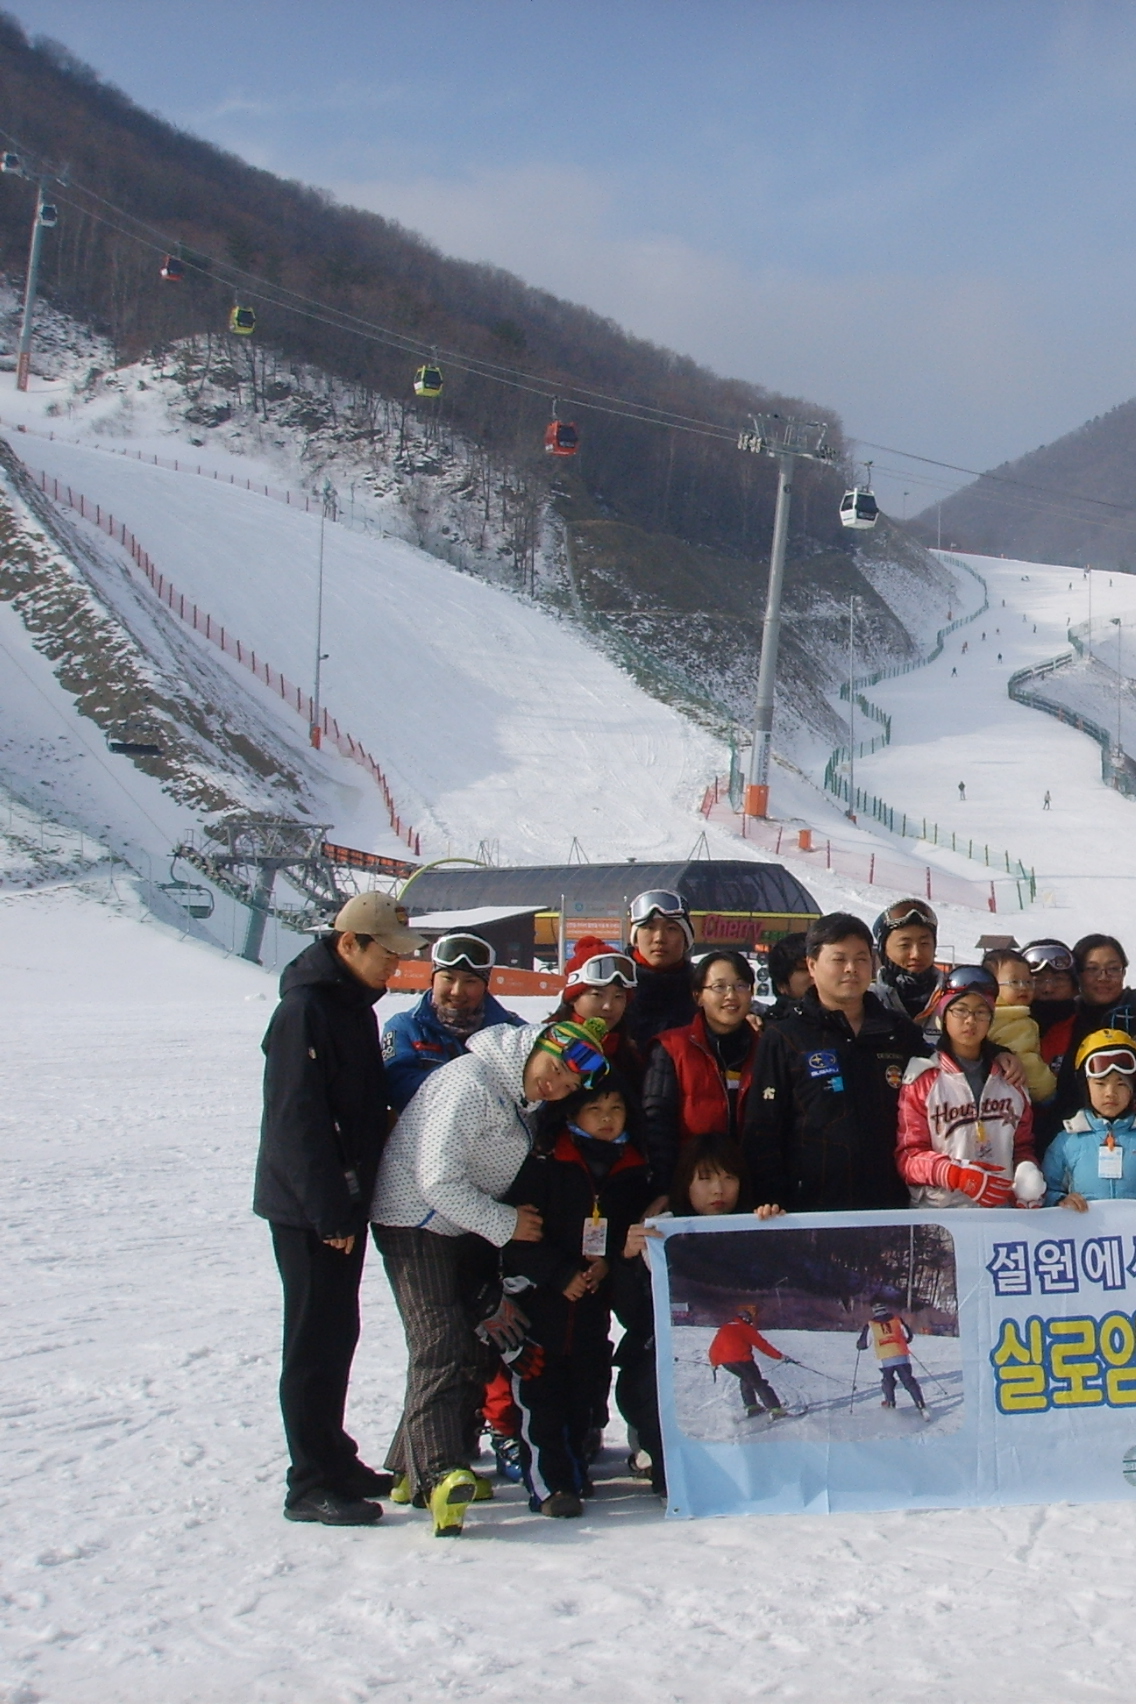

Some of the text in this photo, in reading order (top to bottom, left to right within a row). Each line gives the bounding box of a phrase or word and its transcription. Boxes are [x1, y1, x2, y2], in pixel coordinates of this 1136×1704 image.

[702, 914, 765, 945] Cherry
[811, 1067, 839, 1077] SUBARU
[930, 1097, 1012, 1135] Houston
